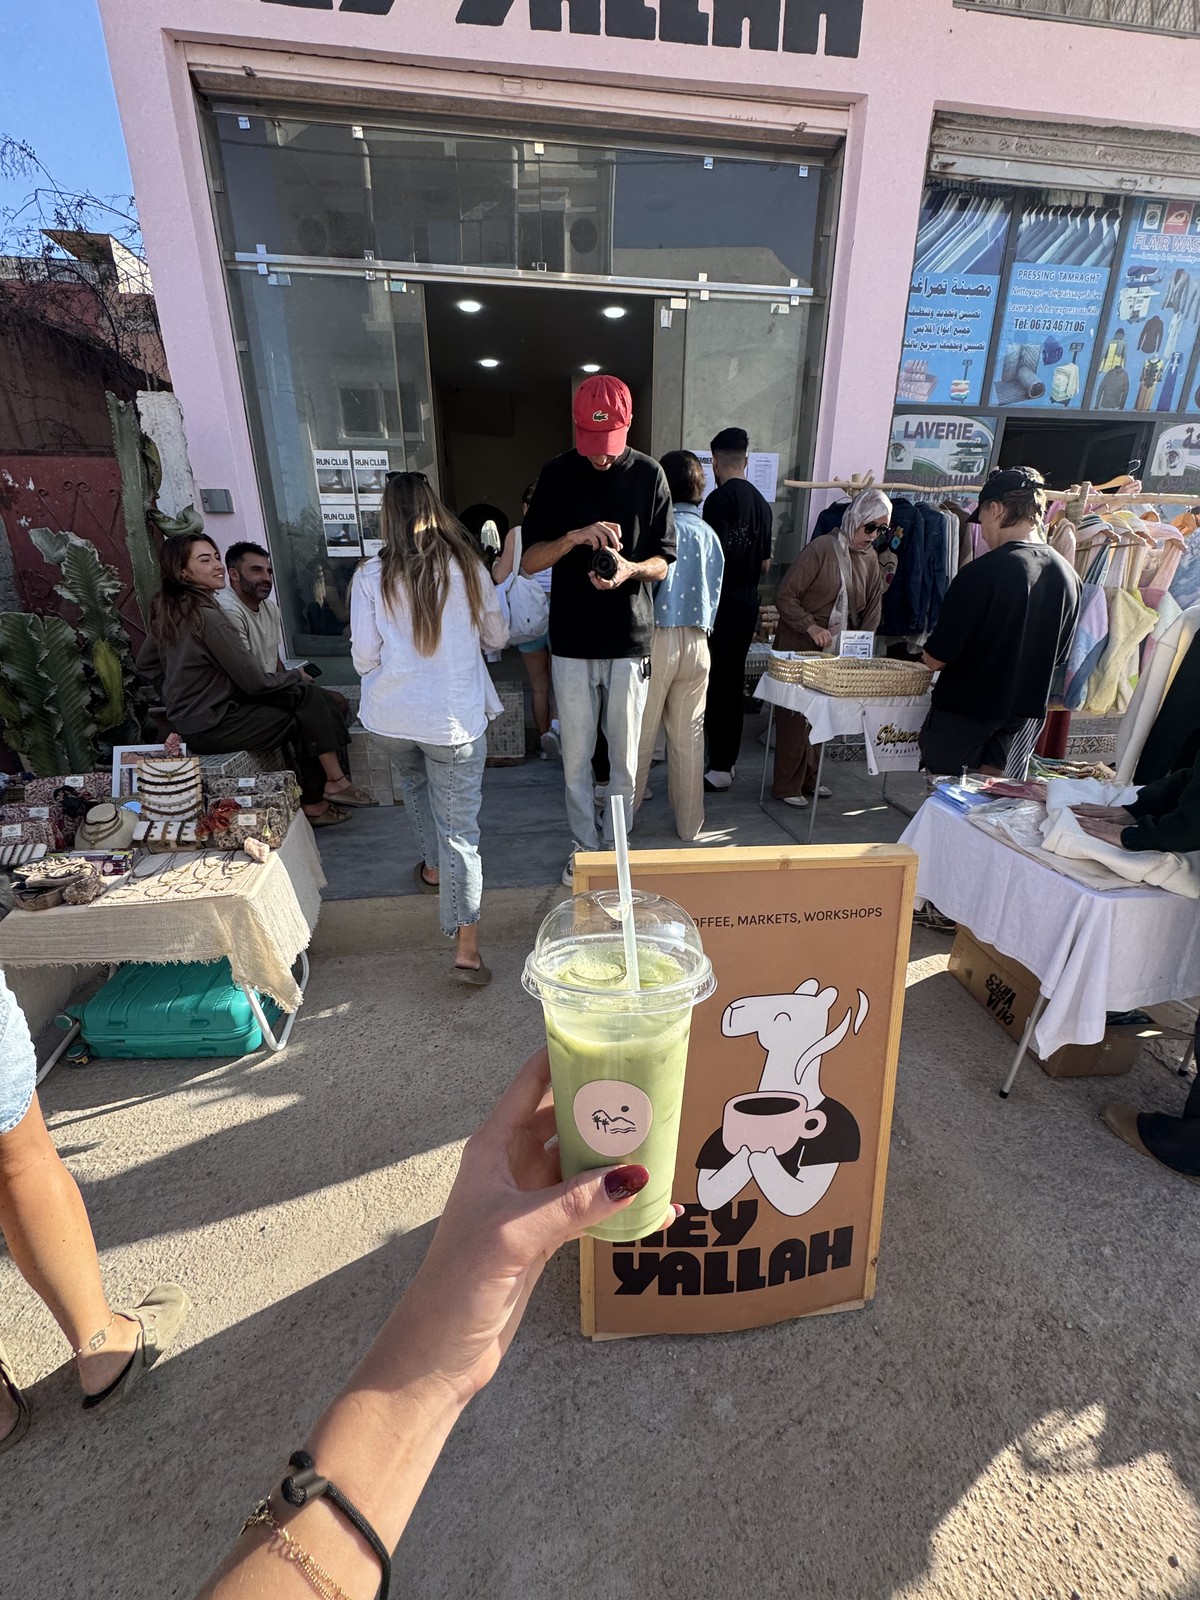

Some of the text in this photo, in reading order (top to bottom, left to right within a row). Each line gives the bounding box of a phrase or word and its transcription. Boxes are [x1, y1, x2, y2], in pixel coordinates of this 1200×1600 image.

[1133, 234, 1200, 253] FLAIR WAS
[1018, 269, 1101, 283] PRESSING TAMRAGHT
[910, 277, 992, 300] مصبنة تمراغ
[1014, 318, 1085, 332] Tél: 06 73 46 71 06
[904, 421, 974, 440] LAVERIE
[316, 458, 349, 466] RUN CLUB
[355, 458, 387, 467] RUN CLUB
[323, 513, 355, 521] RUN CLUB
[692, 916, 735, 929] OFFEE,
[737, 912, 801, 927] MARKETS,
[804, 906, 882, 922] WORKSHOPS
[612, 1225, 854, 1296] YALLAH
